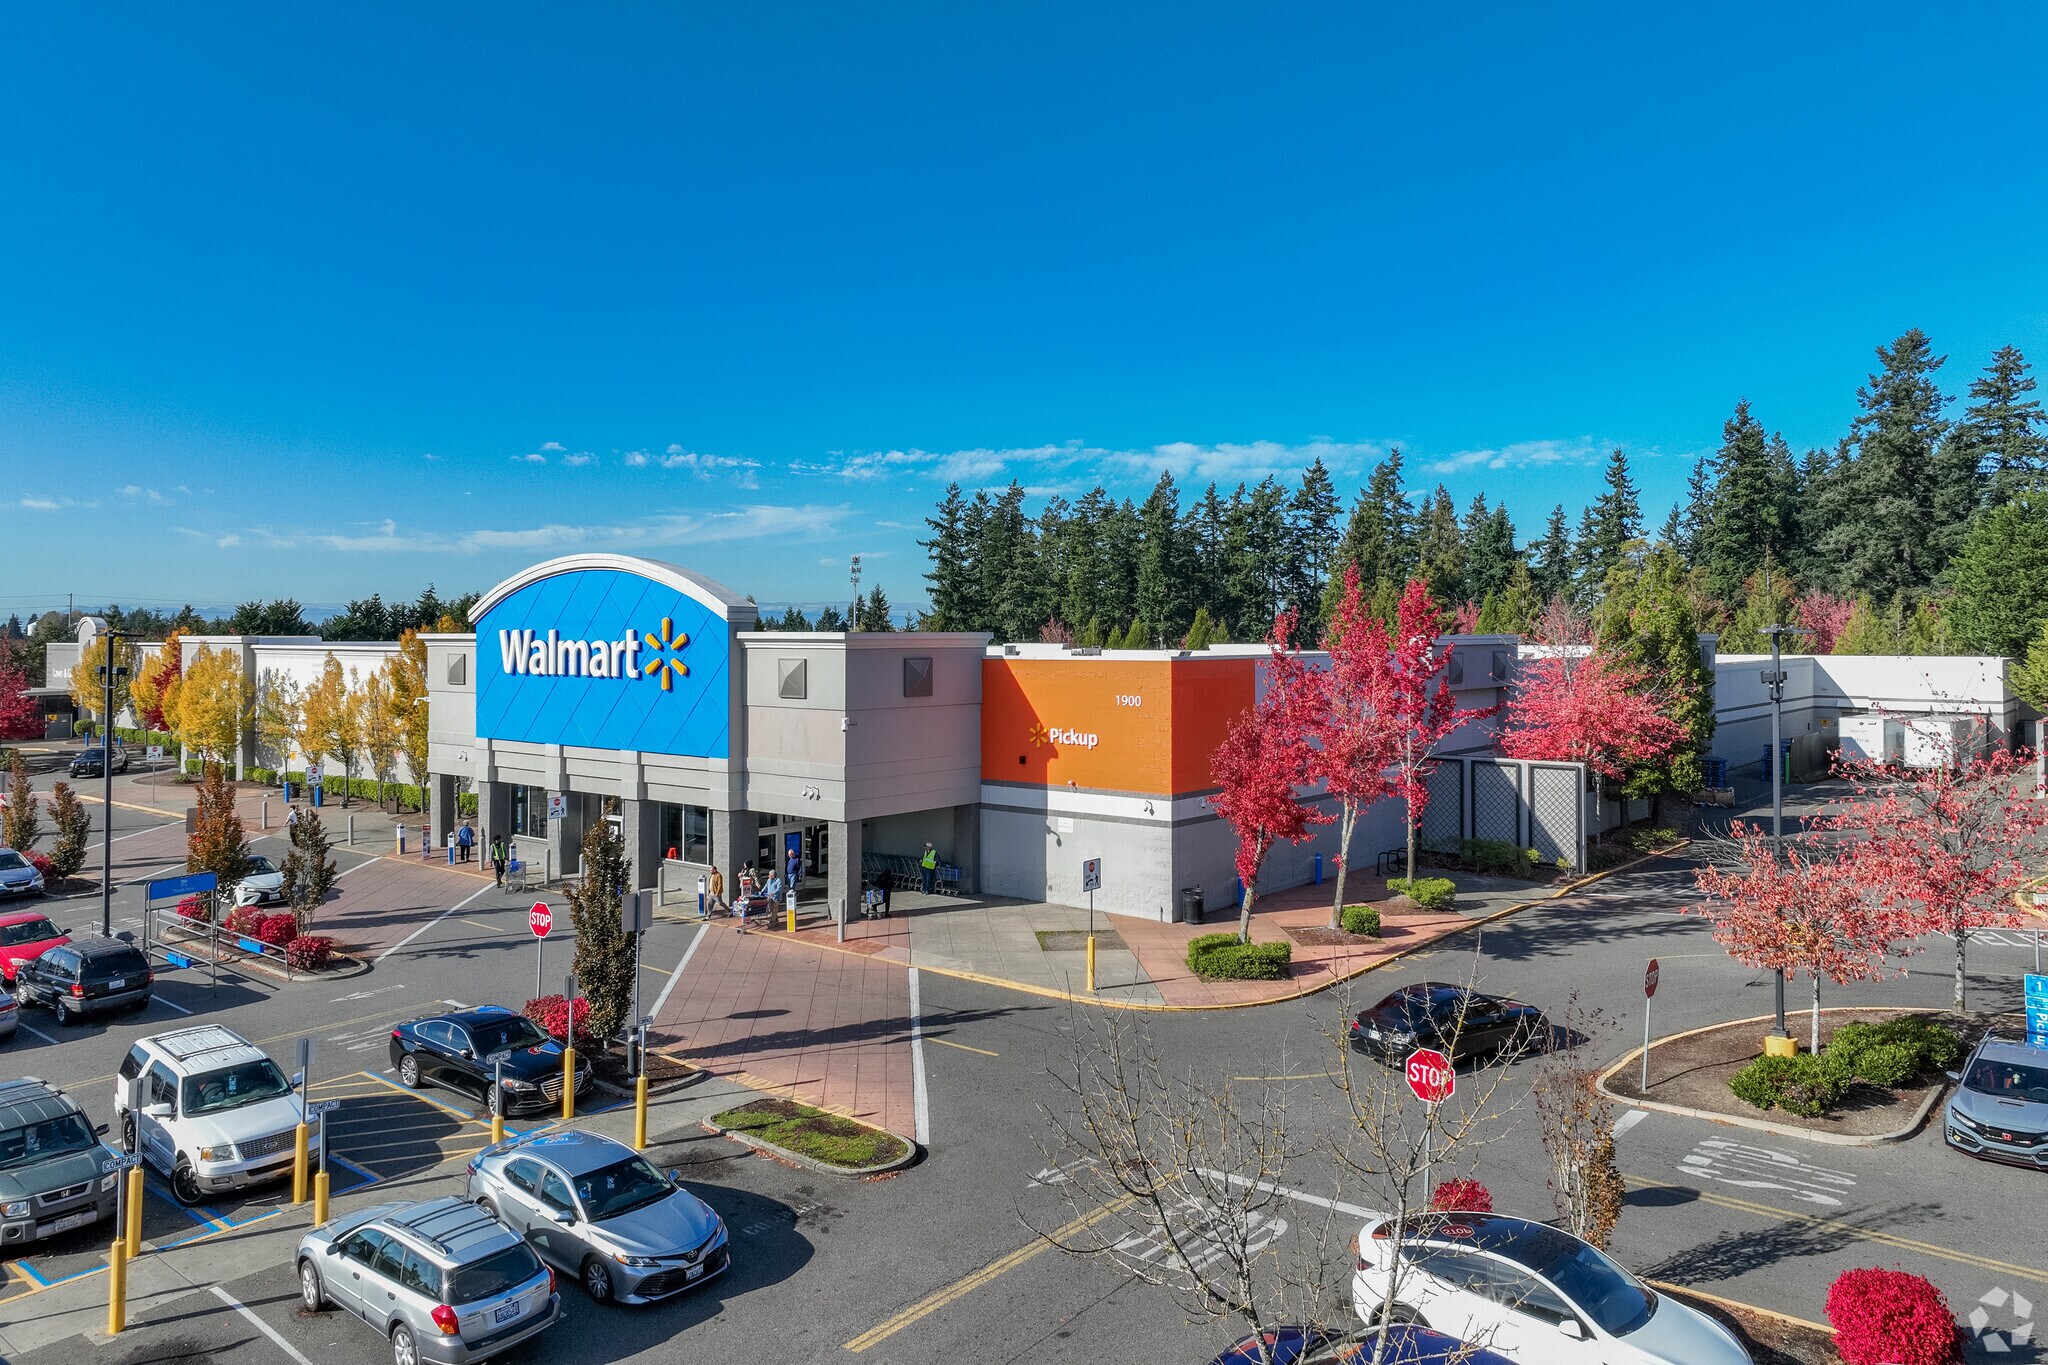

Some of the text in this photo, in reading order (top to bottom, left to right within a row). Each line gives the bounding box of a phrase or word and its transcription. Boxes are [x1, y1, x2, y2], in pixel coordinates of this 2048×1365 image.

[498, 628, 640, 680] Walmart
[1115, 694, 1142, 707] 1900
[1049, 727, 1099, 750] Pickup
[531, 911, 552, 928] STOP
[1645, 969, 1659, 989] STOP
[2036, 980, 2042, 991] 1
[2033, 1012, 2048, 1047] Picu
[487, 1050, 511, 1064] COMPACT
[1409, 1062, 1453, 1088] STOP
[309, 1099, 340, 1115] COMPACT
[104, 1154, 142, 1171] COMPACT
[1674, 1136, 1858, 1206] STOP
